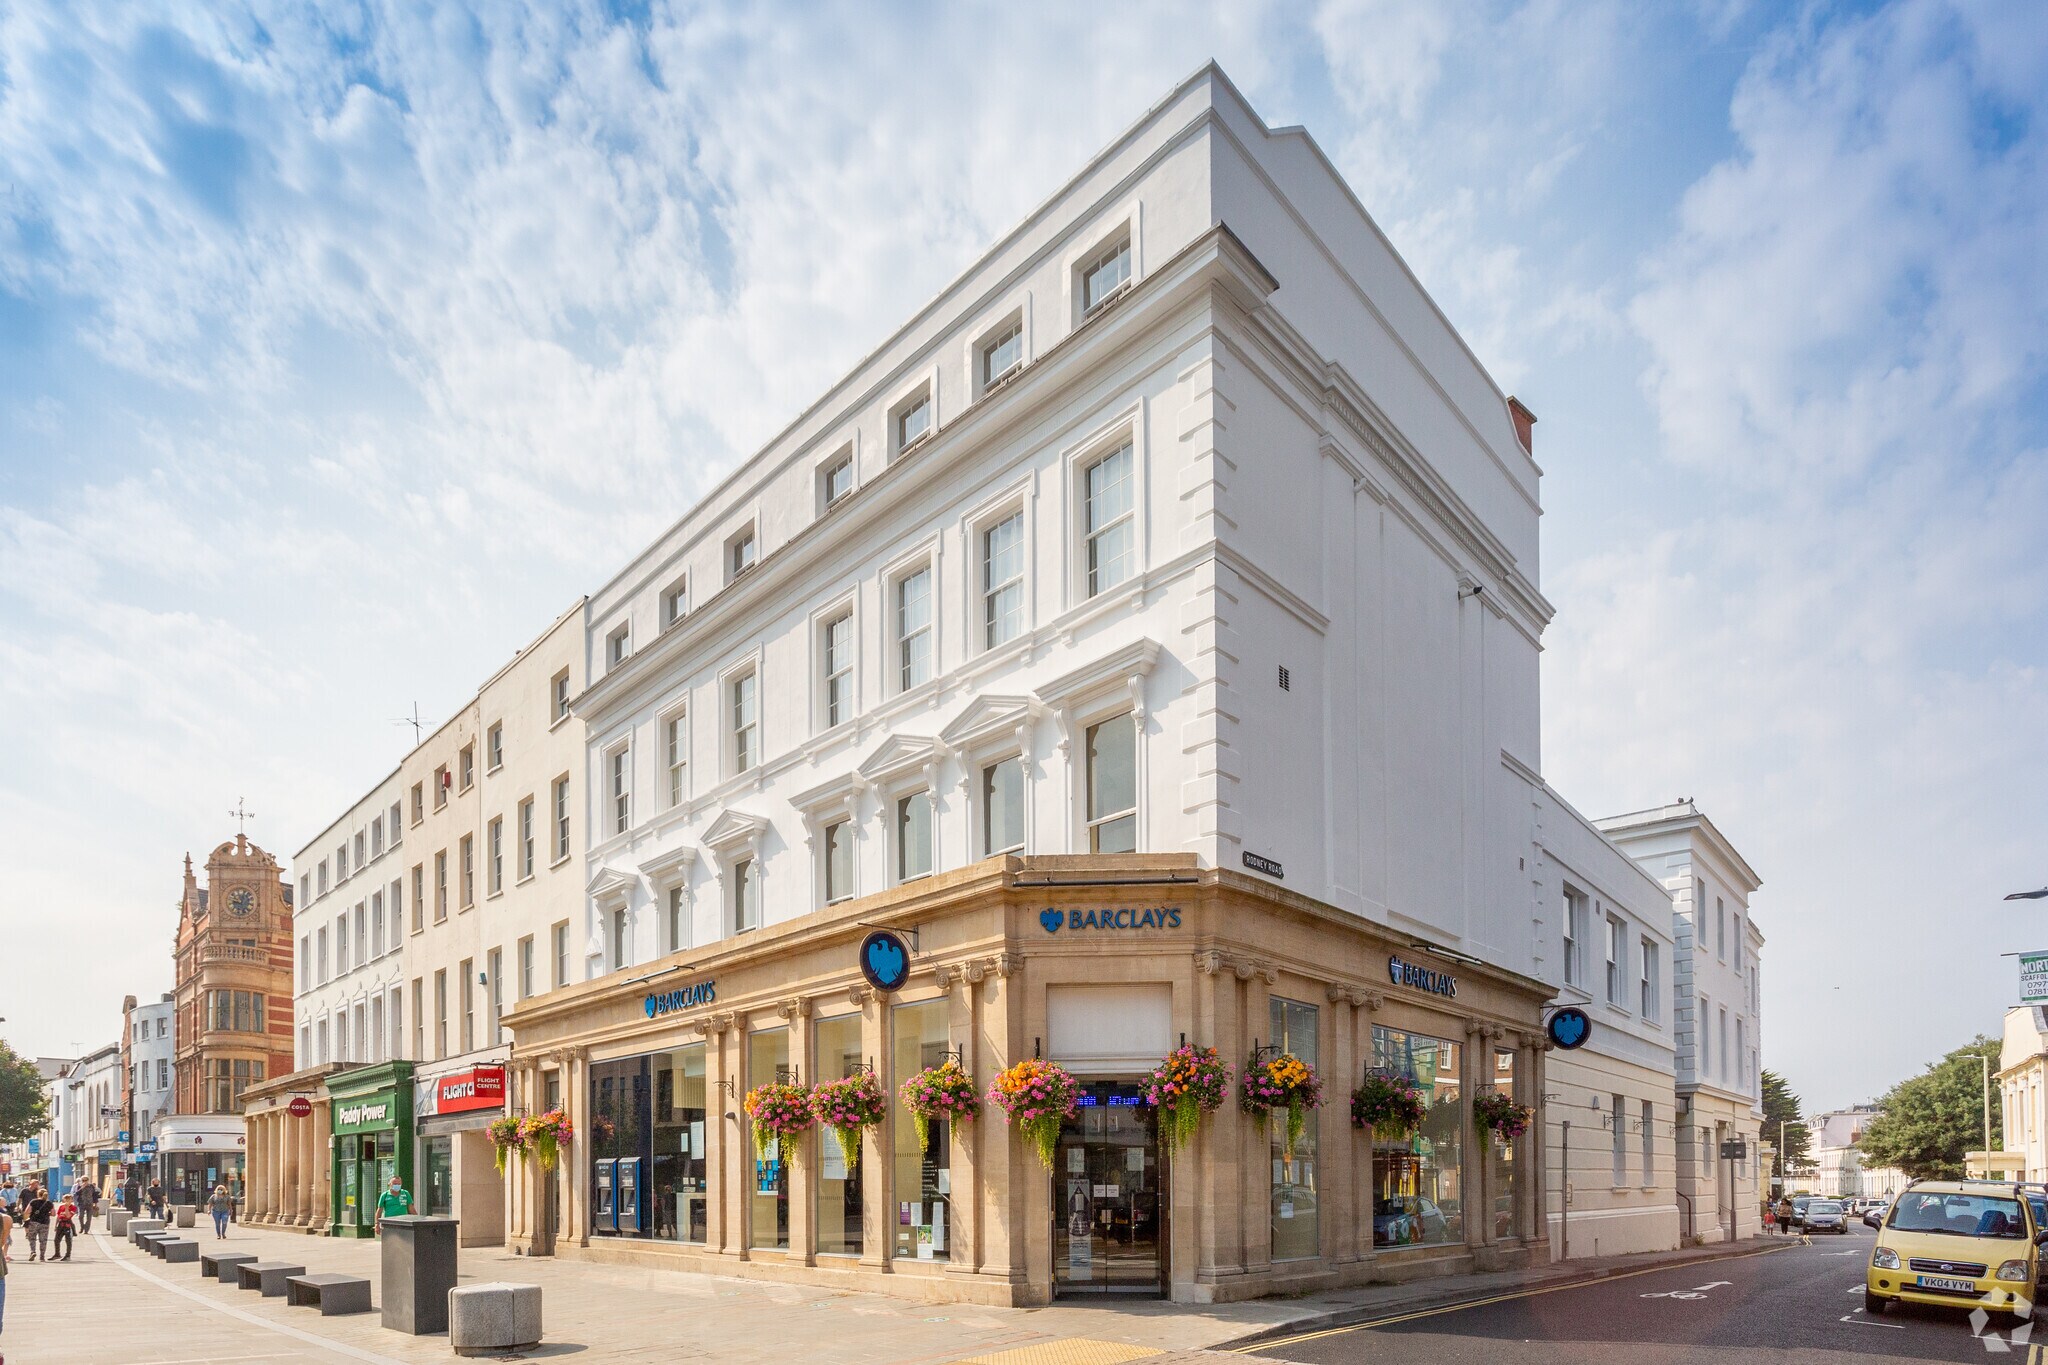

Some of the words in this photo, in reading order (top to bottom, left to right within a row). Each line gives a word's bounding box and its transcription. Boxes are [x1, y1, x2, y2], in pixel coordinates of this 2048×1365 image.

[1246, 855, 1267, 869] RODNEY
[1268, 863, 1282, 875] ROAD
[1068, 908, 1182, 930] BARCLAYS
[1404, 962, 1457, 998] BARCLAYS
[657, 981, 715, 1013] BARCLAYS
[443, 1083, 467, 1100] FLIGHT
[467, 1081, 474, 1096] C
[339, 1106, 361, 1126] Paddy
[361, 1104, 386, 1121] Power
[1924, 1278, 1949, 1288] VK04
[1952, 1280, 1972, 1291] VYM
